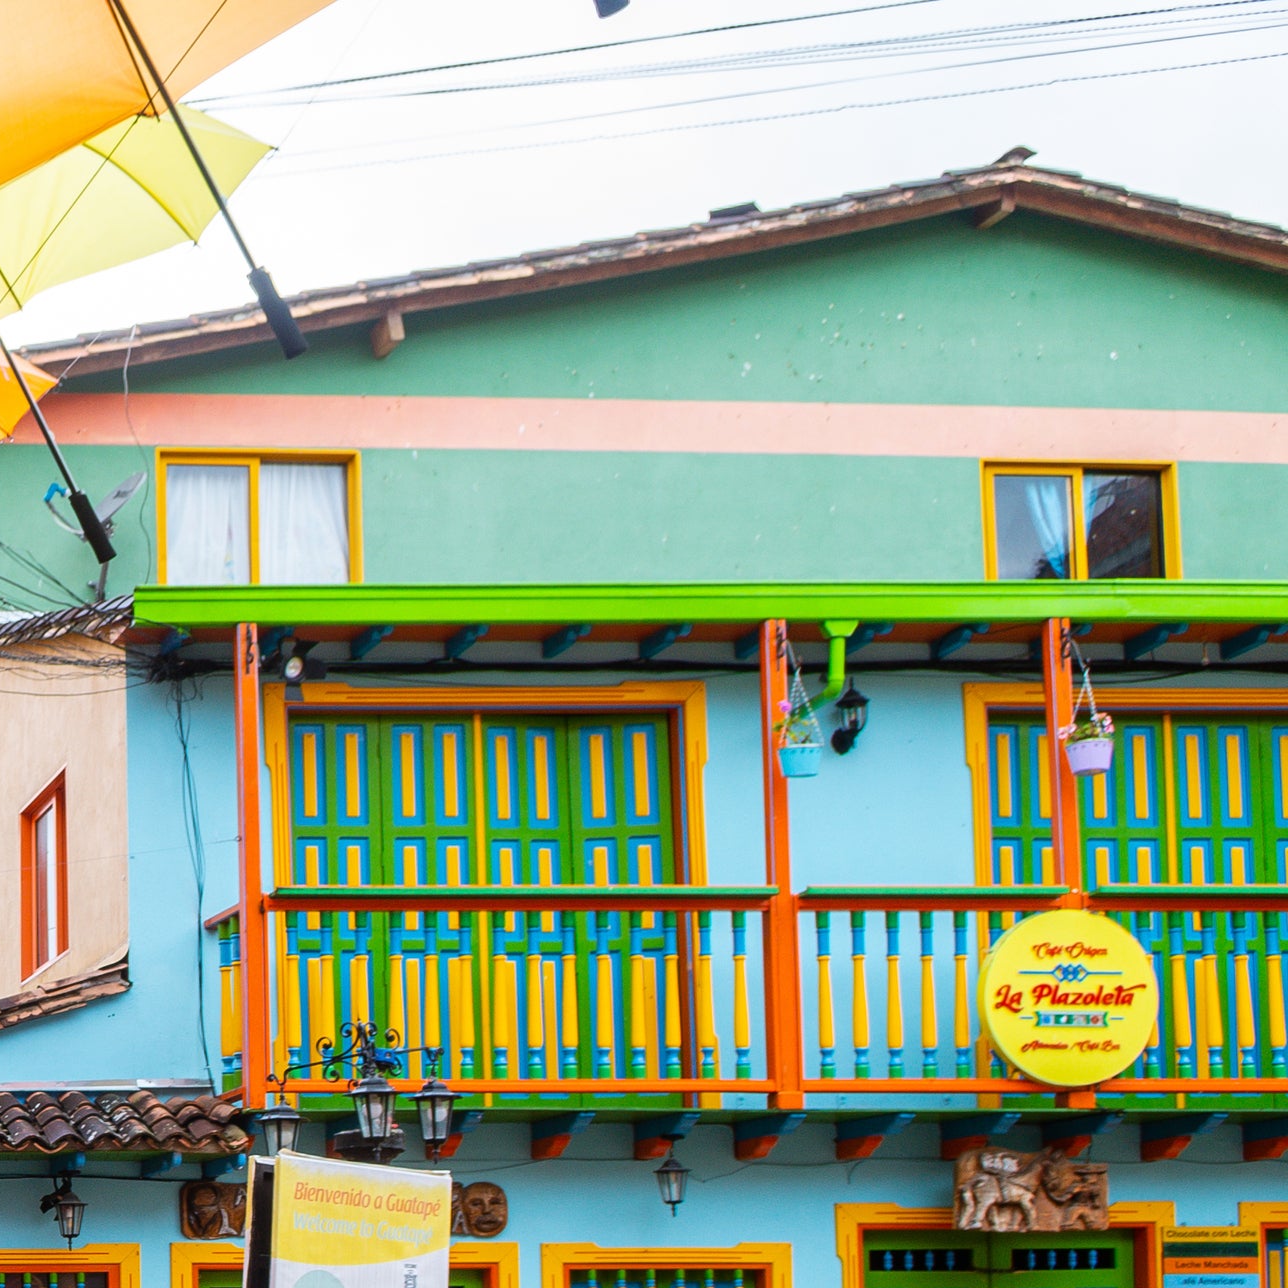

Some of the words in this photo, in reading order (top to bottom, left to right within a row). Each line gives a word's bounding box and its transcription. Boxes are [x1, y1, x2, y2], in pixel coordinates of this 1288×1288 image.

[995, 984, 1024, 1013] La
[1032, 983, 1147, 1006] Plazoleta
[294, 1182, 371, 1208] Bienvenido
[373, 1194, 383, 1210] a
[385, 1193, 441, 1221] Guatapé
[293, 1211, 358, 1236] Welcome
[359, 1218, 374, 1238] to
[377, 1220, 433, 1248] Guatapé
[1166, 1229, 1209, 1238] Chocolate
[1230, 1229, 1257, 1238] Leche
[1175, 1261, 1202, 1269] Leche
[1204, 1261, 1248, 1269] Manchada
[1198, 1277, 1245, 1285] Americano
